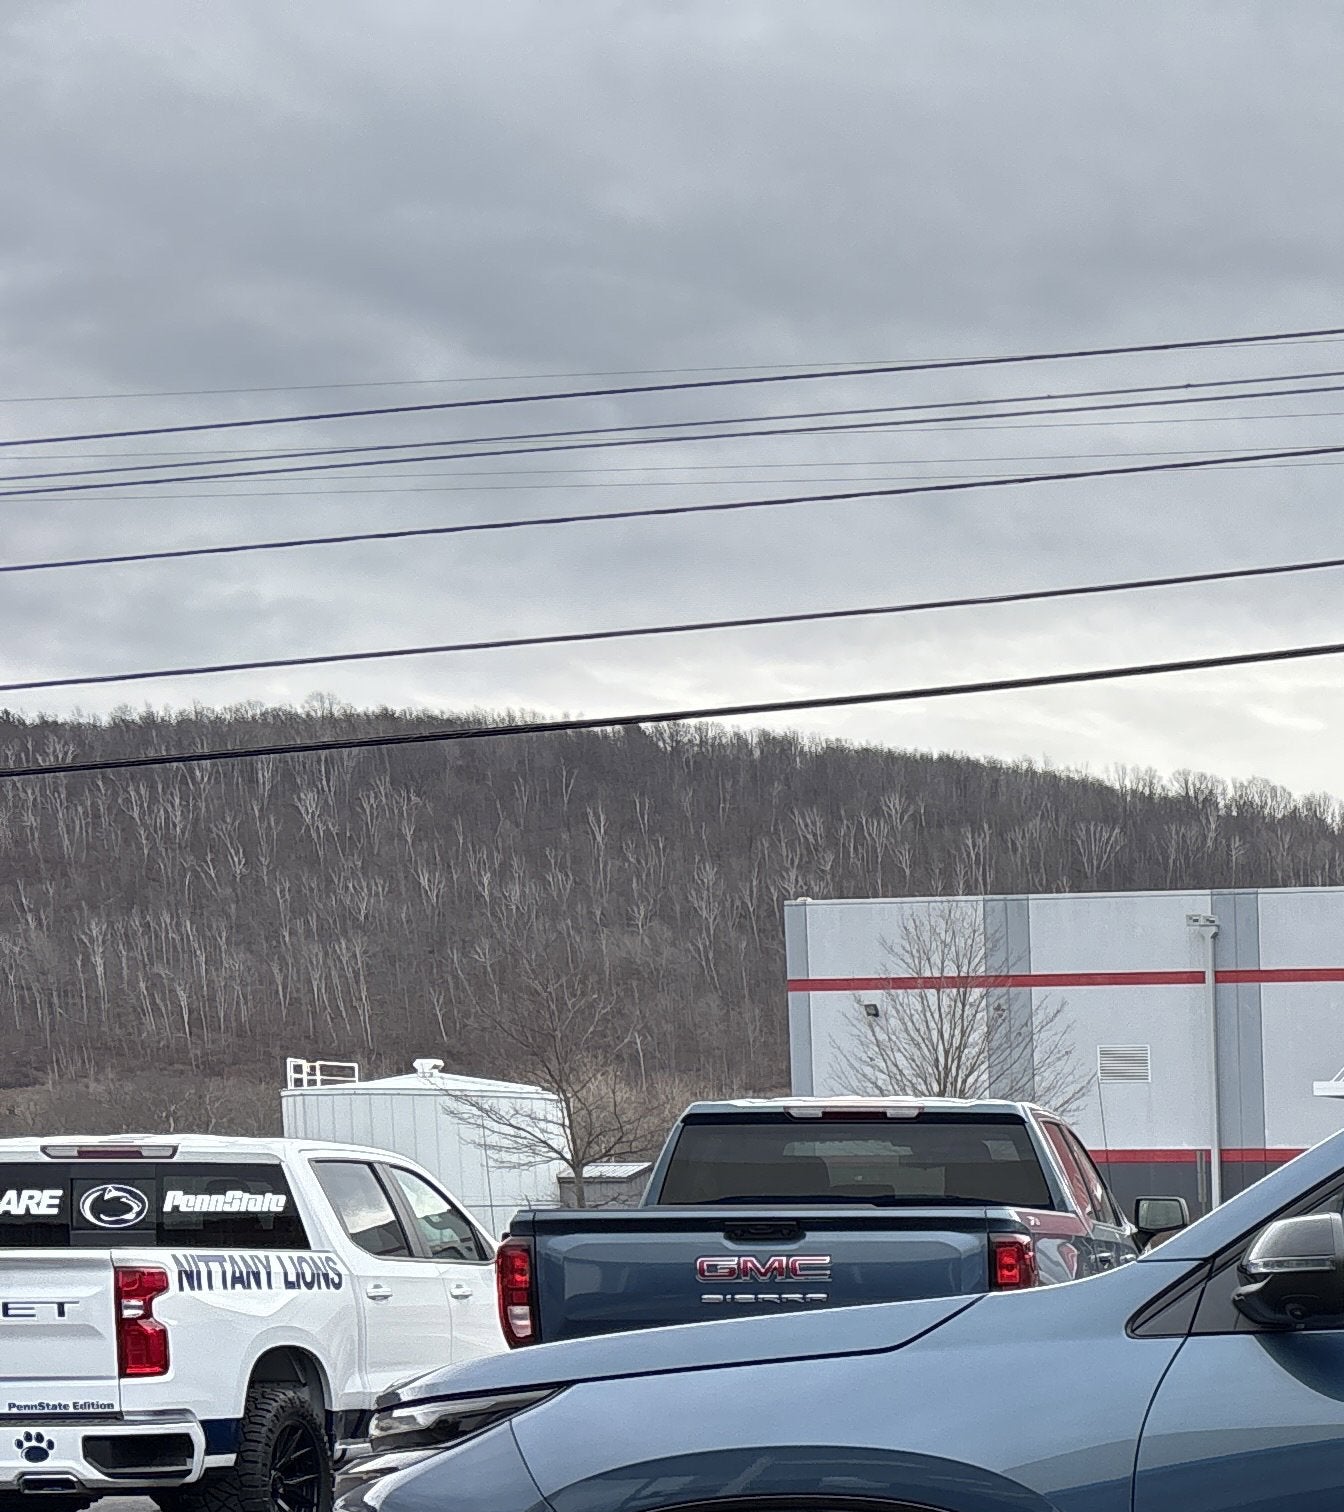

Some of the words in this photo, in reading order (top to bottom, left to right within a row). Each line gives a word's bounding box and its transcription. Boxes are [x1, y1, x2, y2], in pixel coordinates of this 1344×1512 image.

[0, 1189, 63, 1215] ARE
[162, 1190, 287, 1212] PennState
[171, 1253, 274, 1292] NITTANY
[276, 1254, 343, 1291] LIONS
[695, 1254, 833, 1283] GMC
[701, 1293, 829, 1304] SIERRA
[8, 1401, 71, 1412] PennState
[72, 1401, 115, 1411] Edition
